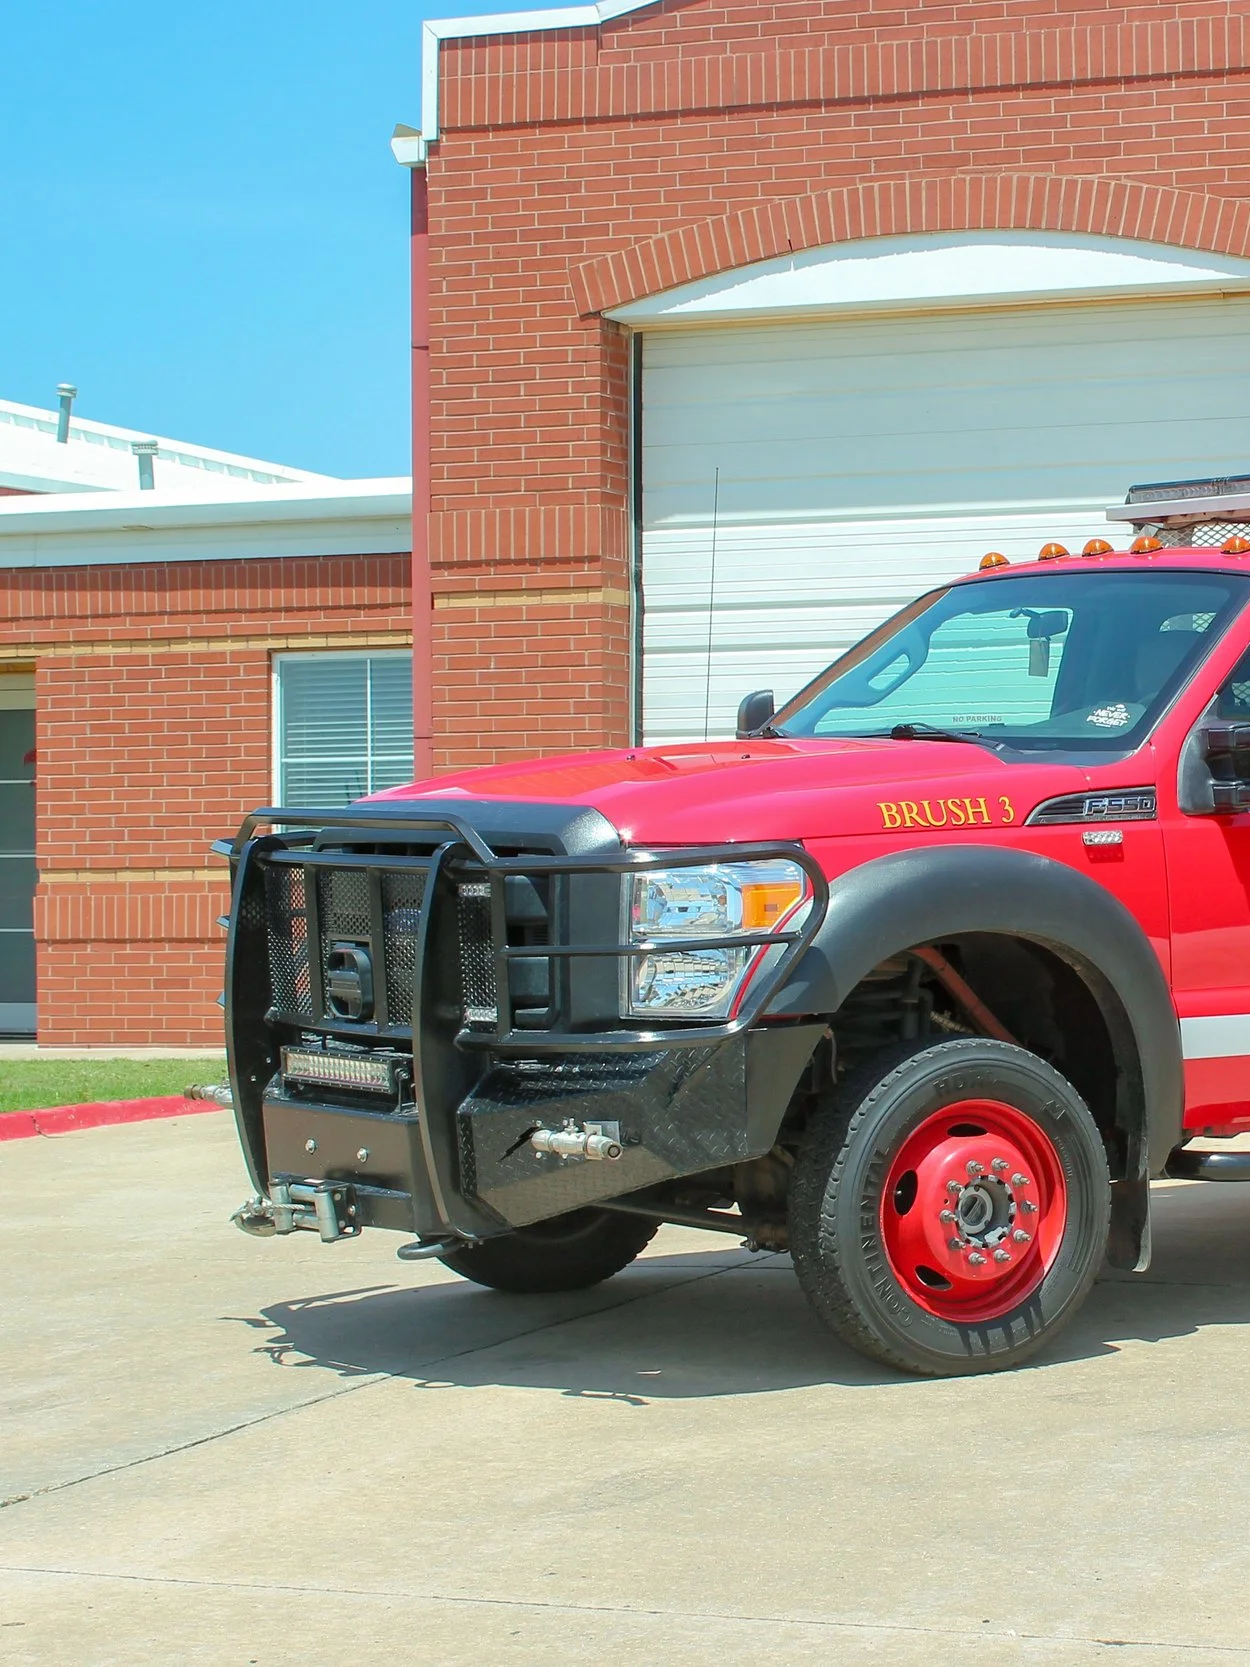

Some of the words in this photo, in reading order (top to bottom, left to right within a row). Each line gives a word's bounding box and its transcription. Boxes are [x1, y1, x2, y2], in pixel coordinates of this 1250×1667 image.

[966, 715, 1002, 723] PARKING
[1094, 709, 1128, 720] NEVER
[1086, 715, 1128, 726] FORGET
[877, 797, 992, 829] BRUSH
[998, 796, 1015, 824] 3
[860, 1146, 913, 1328] CONTINENTAL
